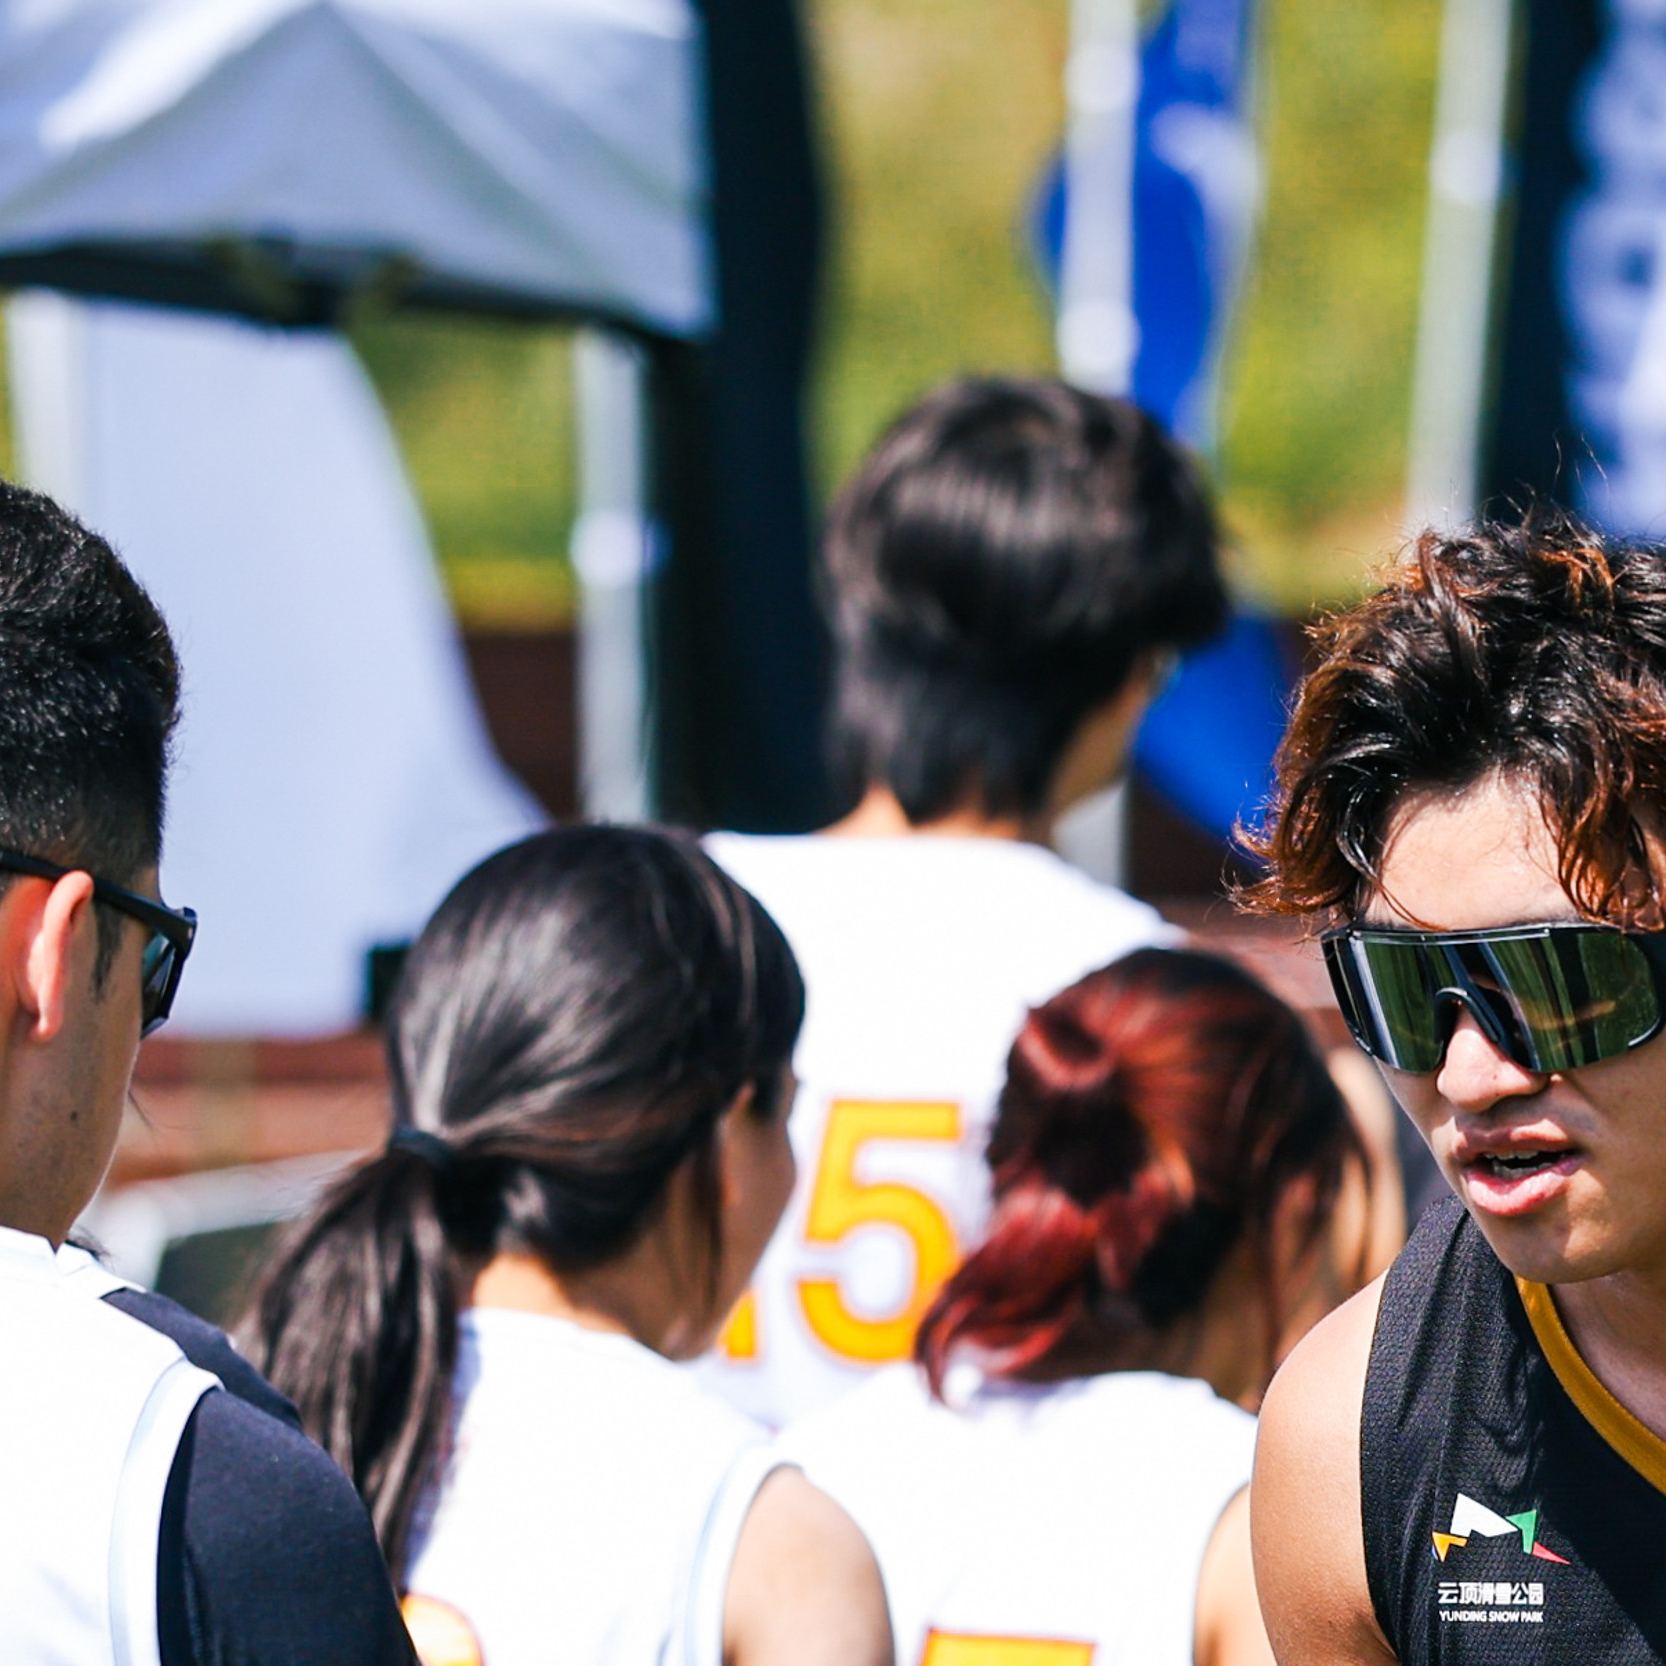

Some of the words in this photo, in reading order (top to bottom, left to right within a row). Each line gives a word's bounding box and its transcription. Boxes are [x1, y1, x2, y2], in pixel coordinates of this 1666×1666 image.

[1437, 1581, 1544, 1605] 云顶滑雪公园
[1439, 1610, 1487, 1622] YUNDING
[1488, 1610, 1520, 1622] SNOW
[1520, 1611, 1544, 1622] PARK
